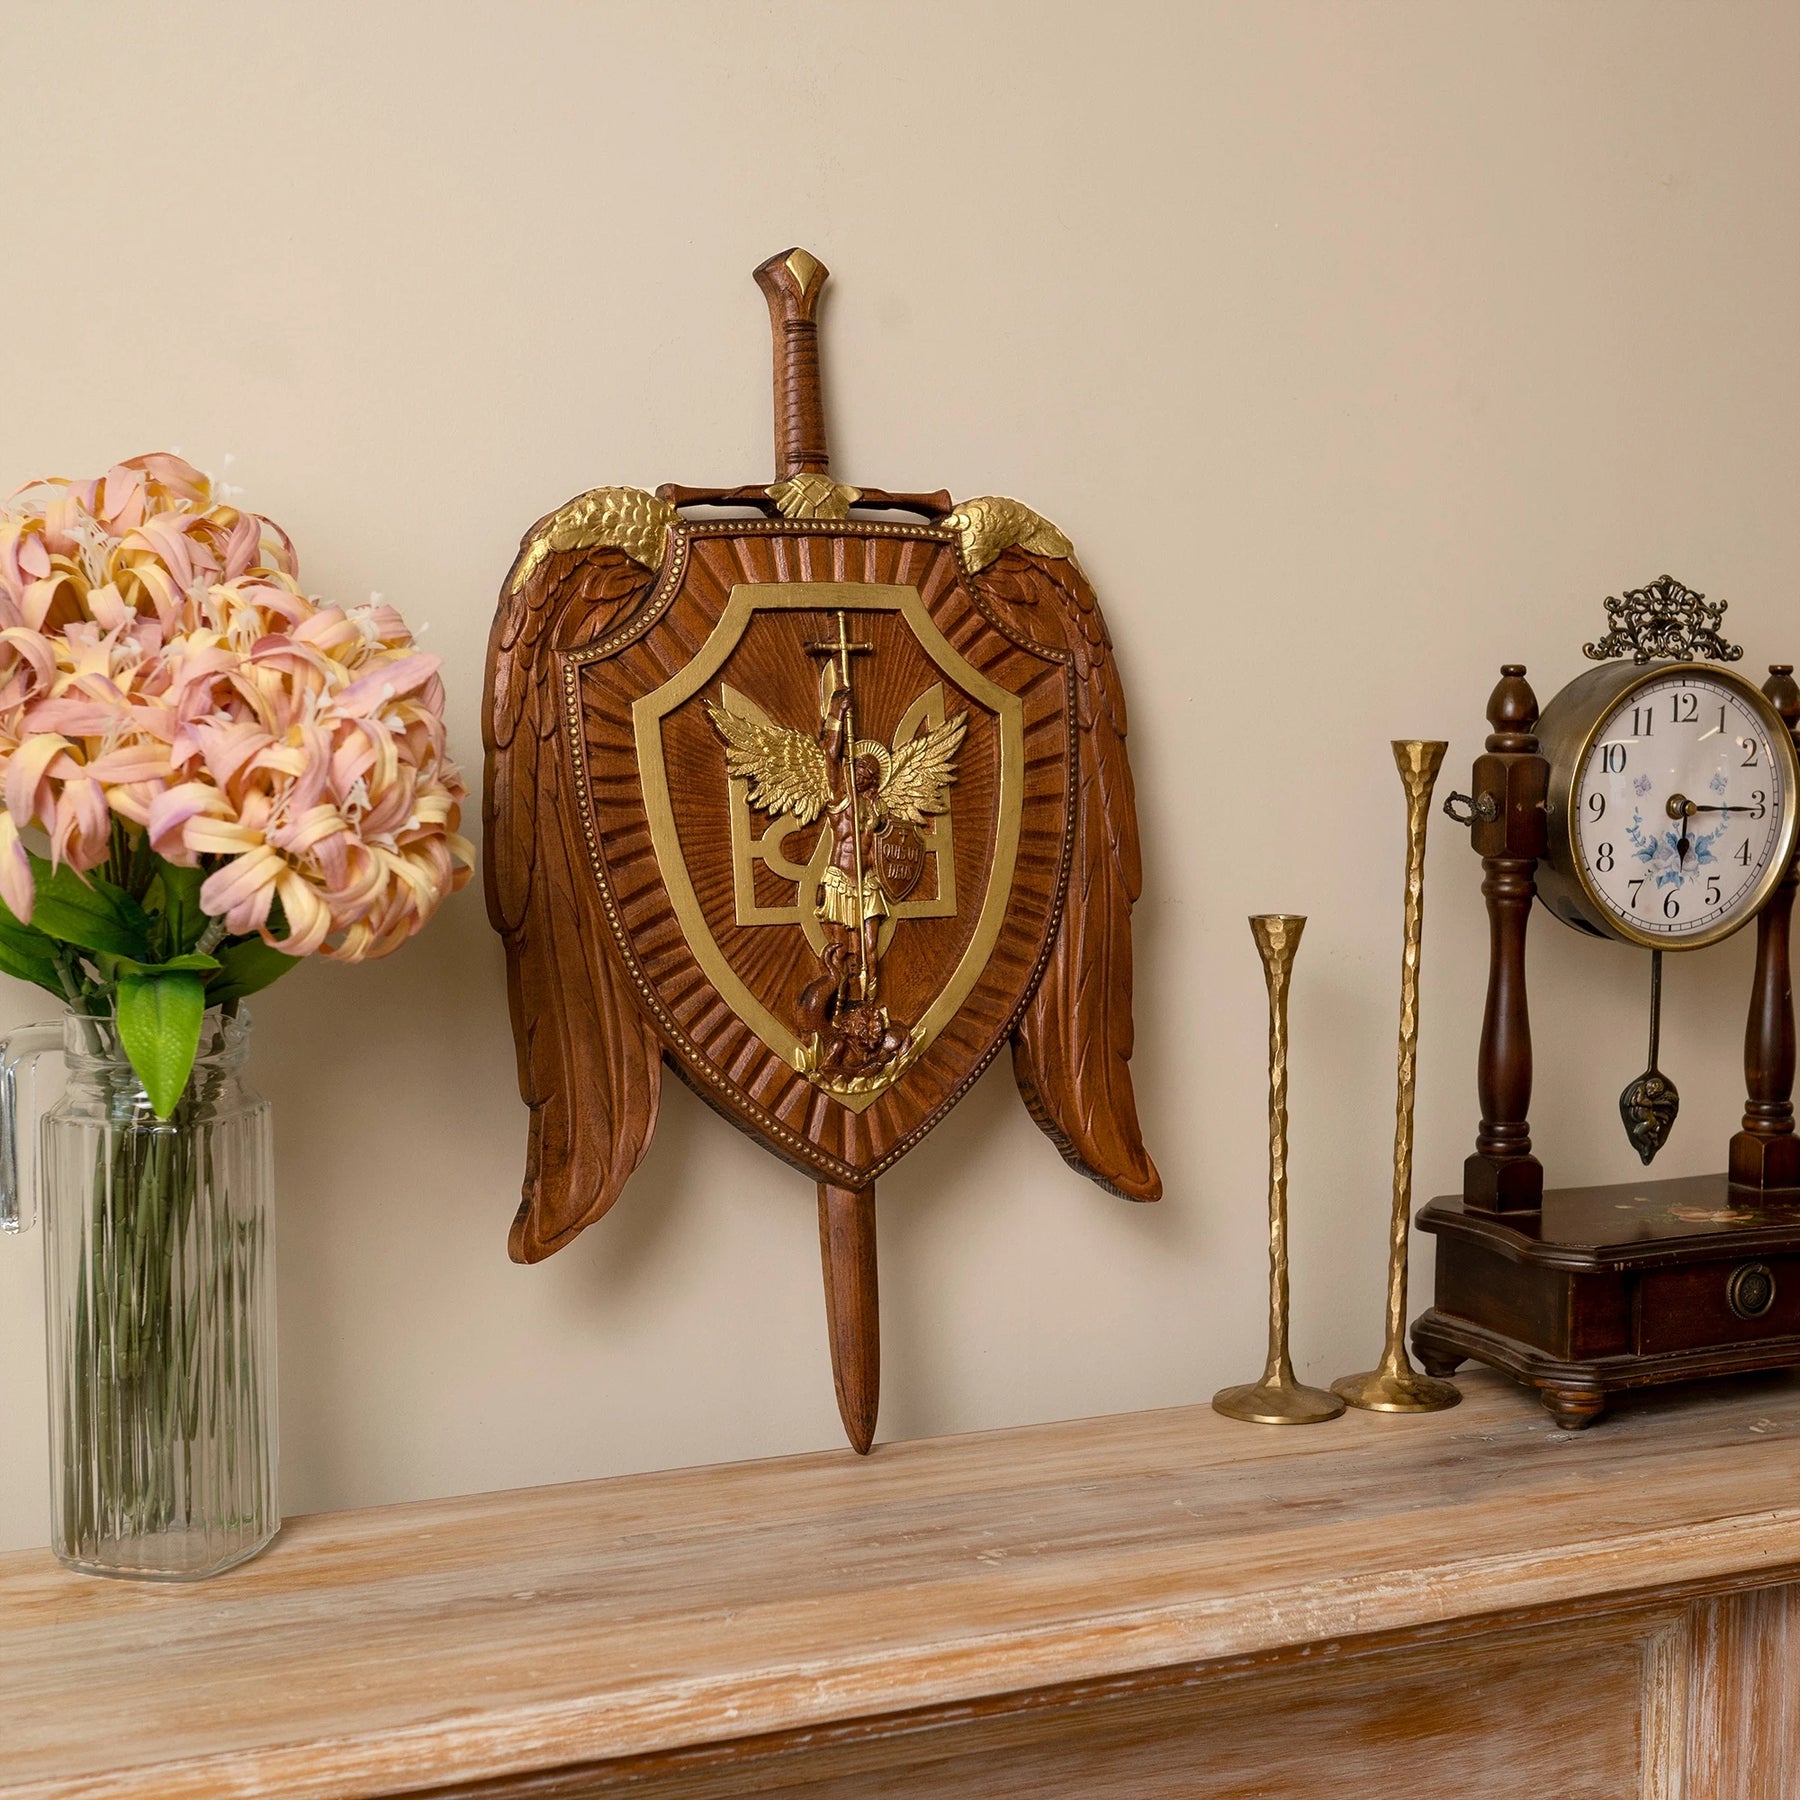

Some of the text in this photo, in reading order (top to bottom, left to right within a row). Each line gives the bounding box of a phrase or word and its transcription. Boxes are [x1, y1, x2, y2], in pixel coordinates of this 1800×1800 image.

[1630, 706, 1654, 736] 11
[1670, 693, 1699, 723] 12
[1718, 705, 1727, 734] 1
[1600, 743, 1626, 773] 10
[1741, 738, 1758, 767] 2
[1589, 793, 1606, 823] 9
[1750, 791, 1765, 819] 3
[1596, 843, 1614, 872] 8
[1734, 838, 1751, 866] 4
[1628, 879, 1647, 908] 7
[1663, 889, 1680, 918] 6
[1705, 876, 1721, 905] 5
